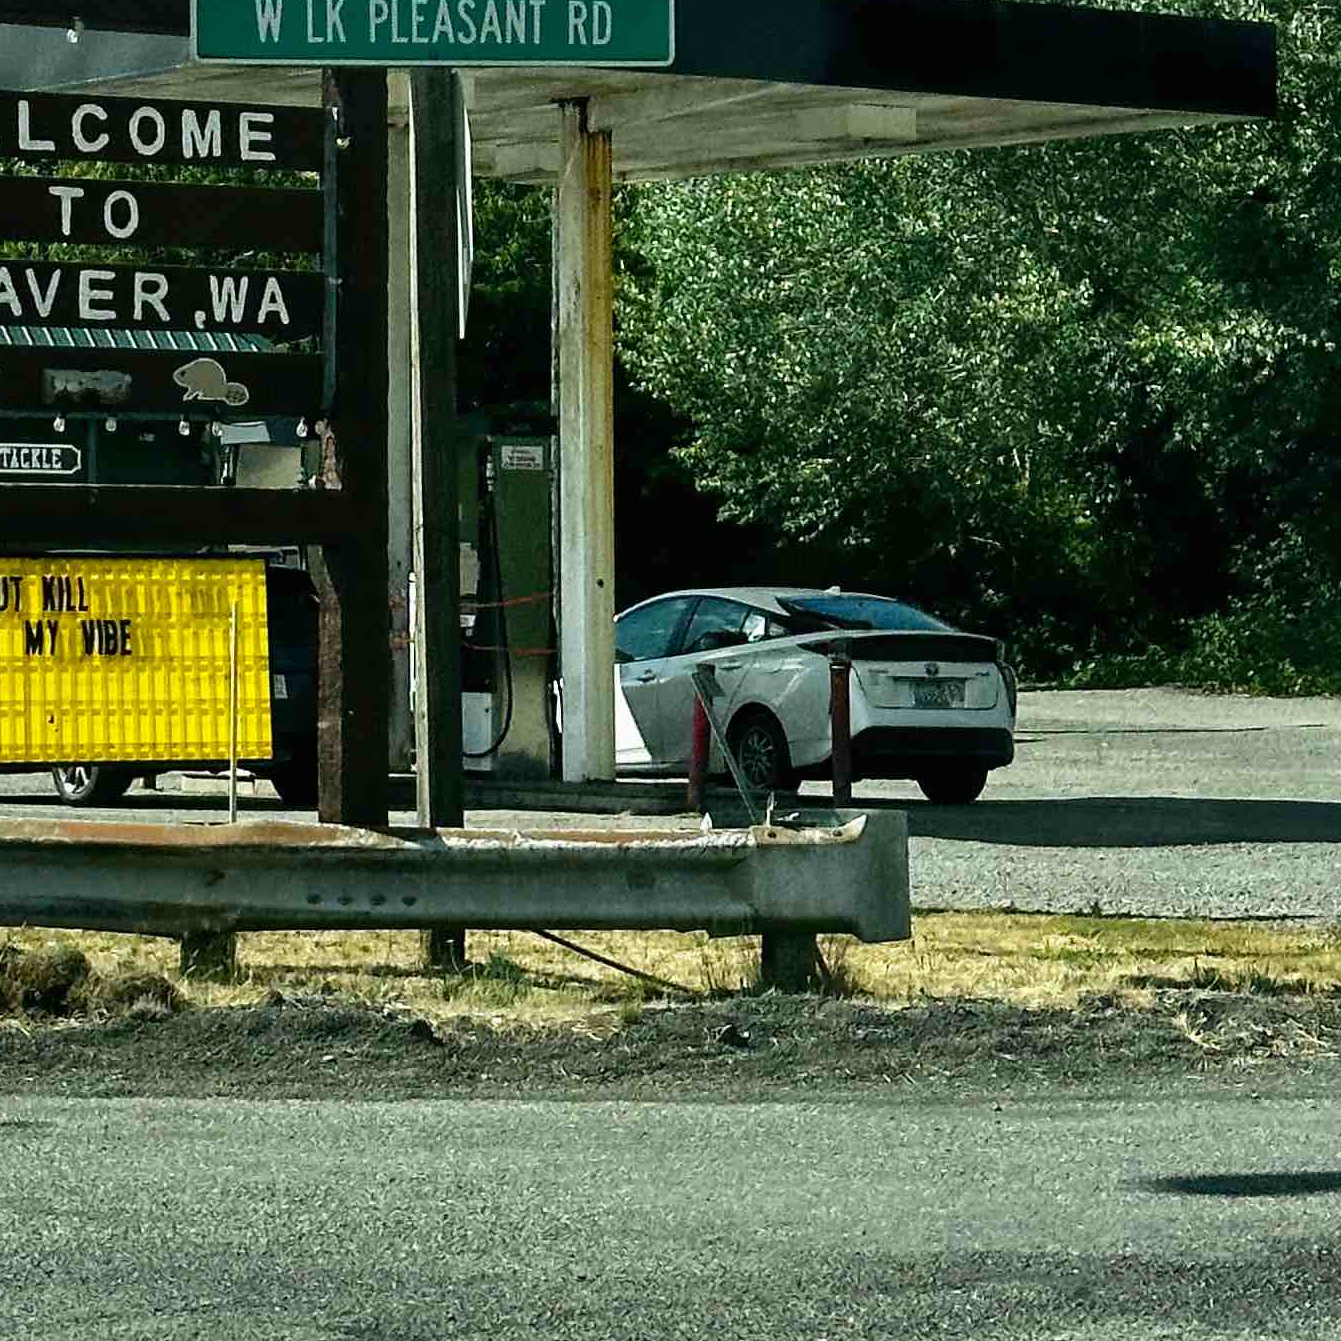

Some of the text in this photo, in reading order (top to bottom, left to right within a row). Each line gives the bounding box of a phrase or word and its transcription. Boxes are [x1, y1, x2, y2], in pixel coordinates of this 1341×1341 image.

[568, 0, 613, 46] RD
[49, 185, 140, 239] TO
[42, 576, 89, 612] KILL
[25, 619, 133, 656] MY VIBE
